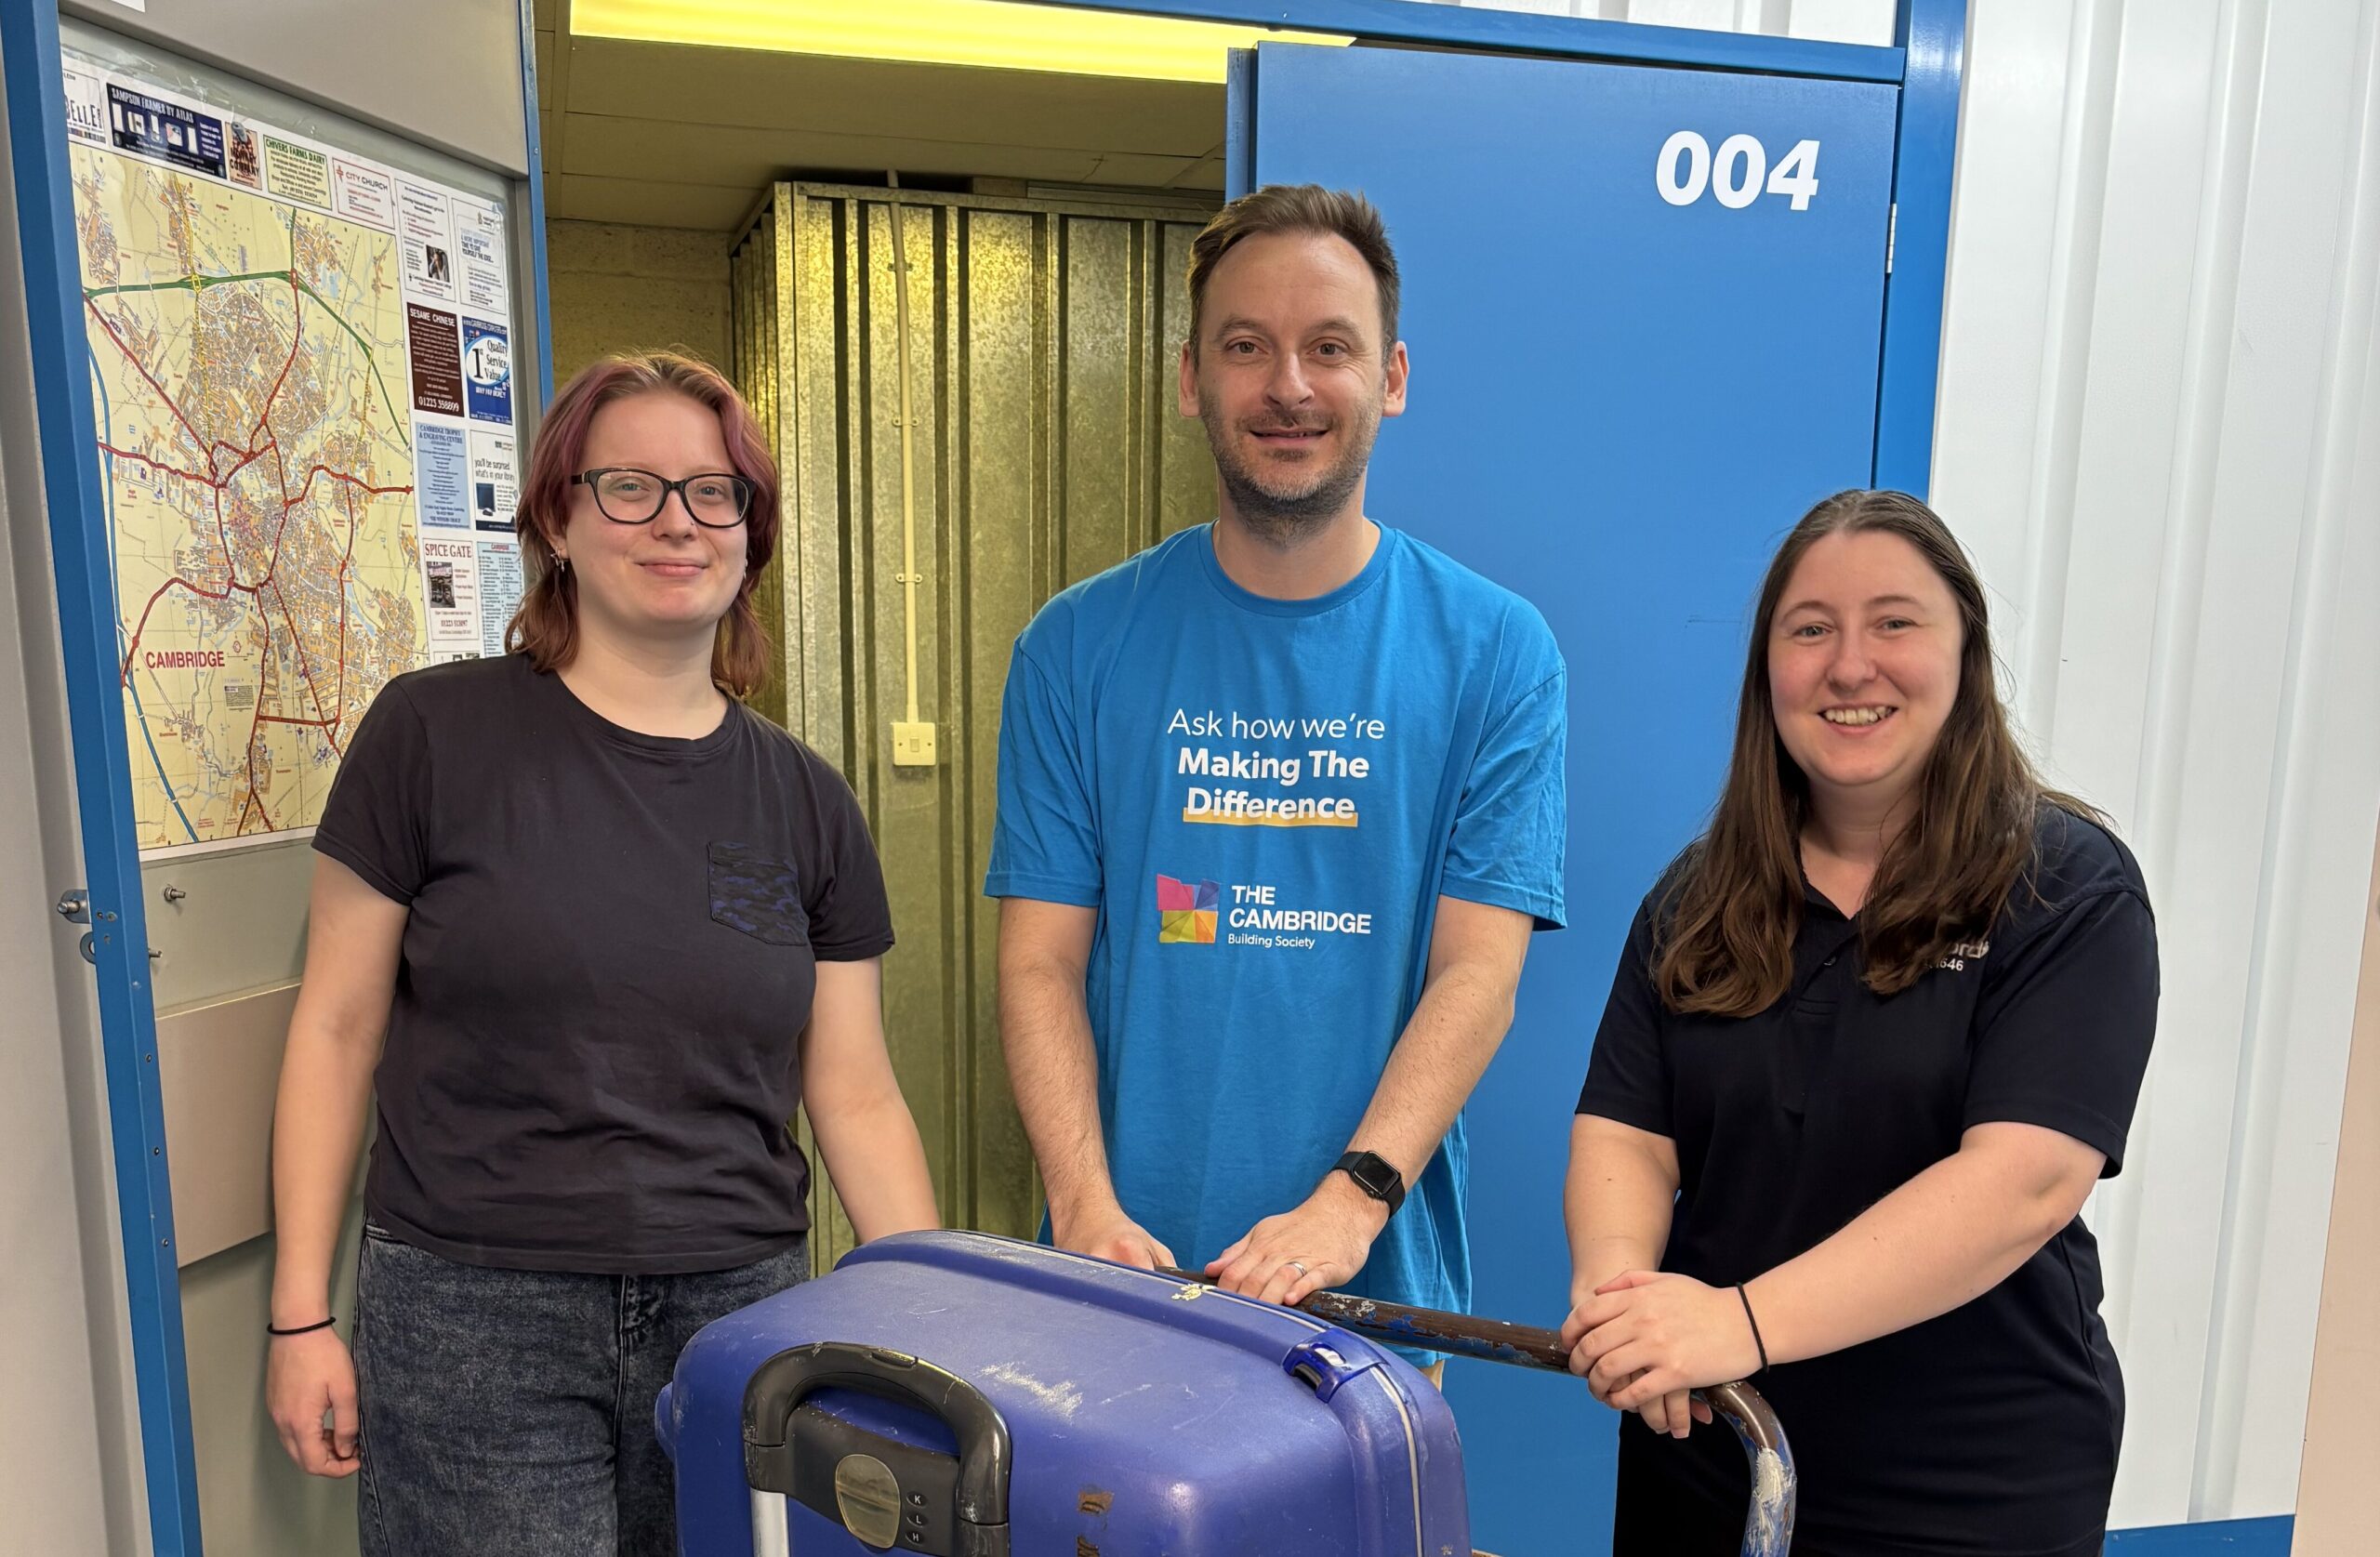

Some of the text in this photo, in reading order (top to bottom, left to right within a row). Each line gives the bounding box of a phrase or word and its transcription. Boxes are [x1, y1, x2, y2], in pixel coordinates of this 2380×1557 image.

[266, 139, 325, 165] CHIVERS FARMS DAIRY
[1656, 130, 1820, 211] 004
[346, 171, 388, 191] CITY CHURCH
[410, 308, 430, 322] SESAME
[432, 313, 456, 327] CHINESE
[487, 339, 508, 358] Quality
[486, 354, 507, 368] Service
[418, 396, 437, 408] 01223
[425, 543, 472, 558] SPICE GATE
[146, 652, 226, 668] CAMBRIDGE
[1167, 708, 1223, 738] Ask
[1232, 711, 1296, 740] how
[1178, 747, 1369, 786] Making The
[1186, 787, 1355, 820] Difference
[1231, 885, 1276, 905] THE
[1229, 908, 1372, 934] CAMBRIDGE
[1227, 933, 1316, 949] Building Society
[914, 1495, 921, 1504] K
[916, 1515, 922, 1524] L
[912, 1533, 919, 1541] H
